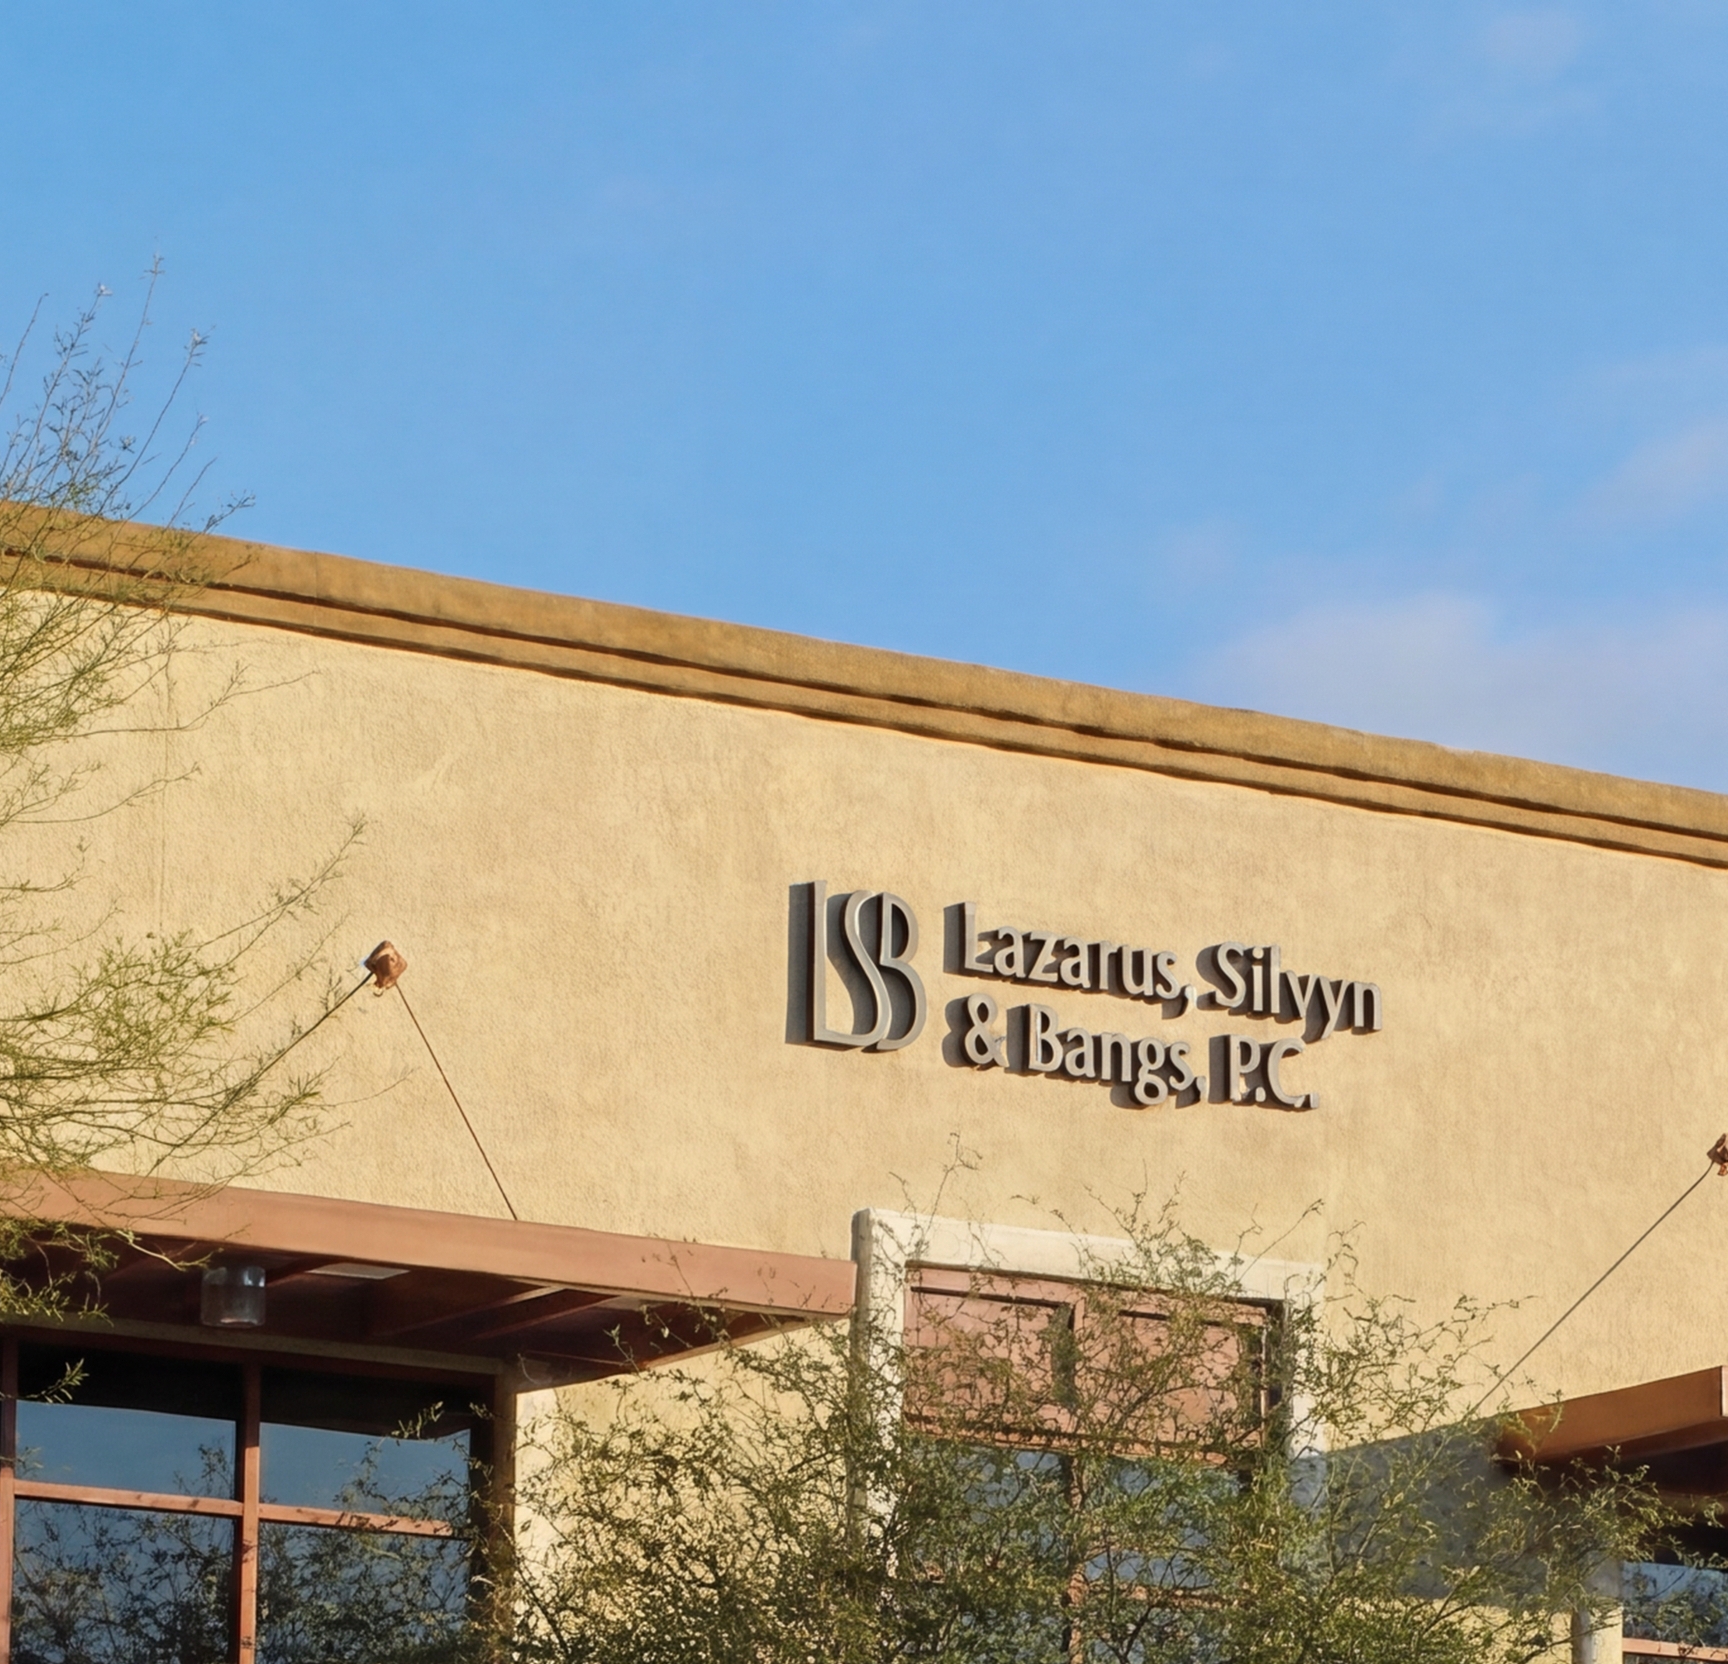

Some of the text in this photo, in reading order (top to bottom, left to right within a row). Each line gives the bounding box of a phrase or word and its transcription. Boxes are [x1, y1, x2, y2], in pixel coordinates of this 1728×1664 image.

[943, 901, 1197, 1019] Lazarus,
[942, 992, 1009, 1068] &
[1006, 1002, 1208, 1109] Bangs,
